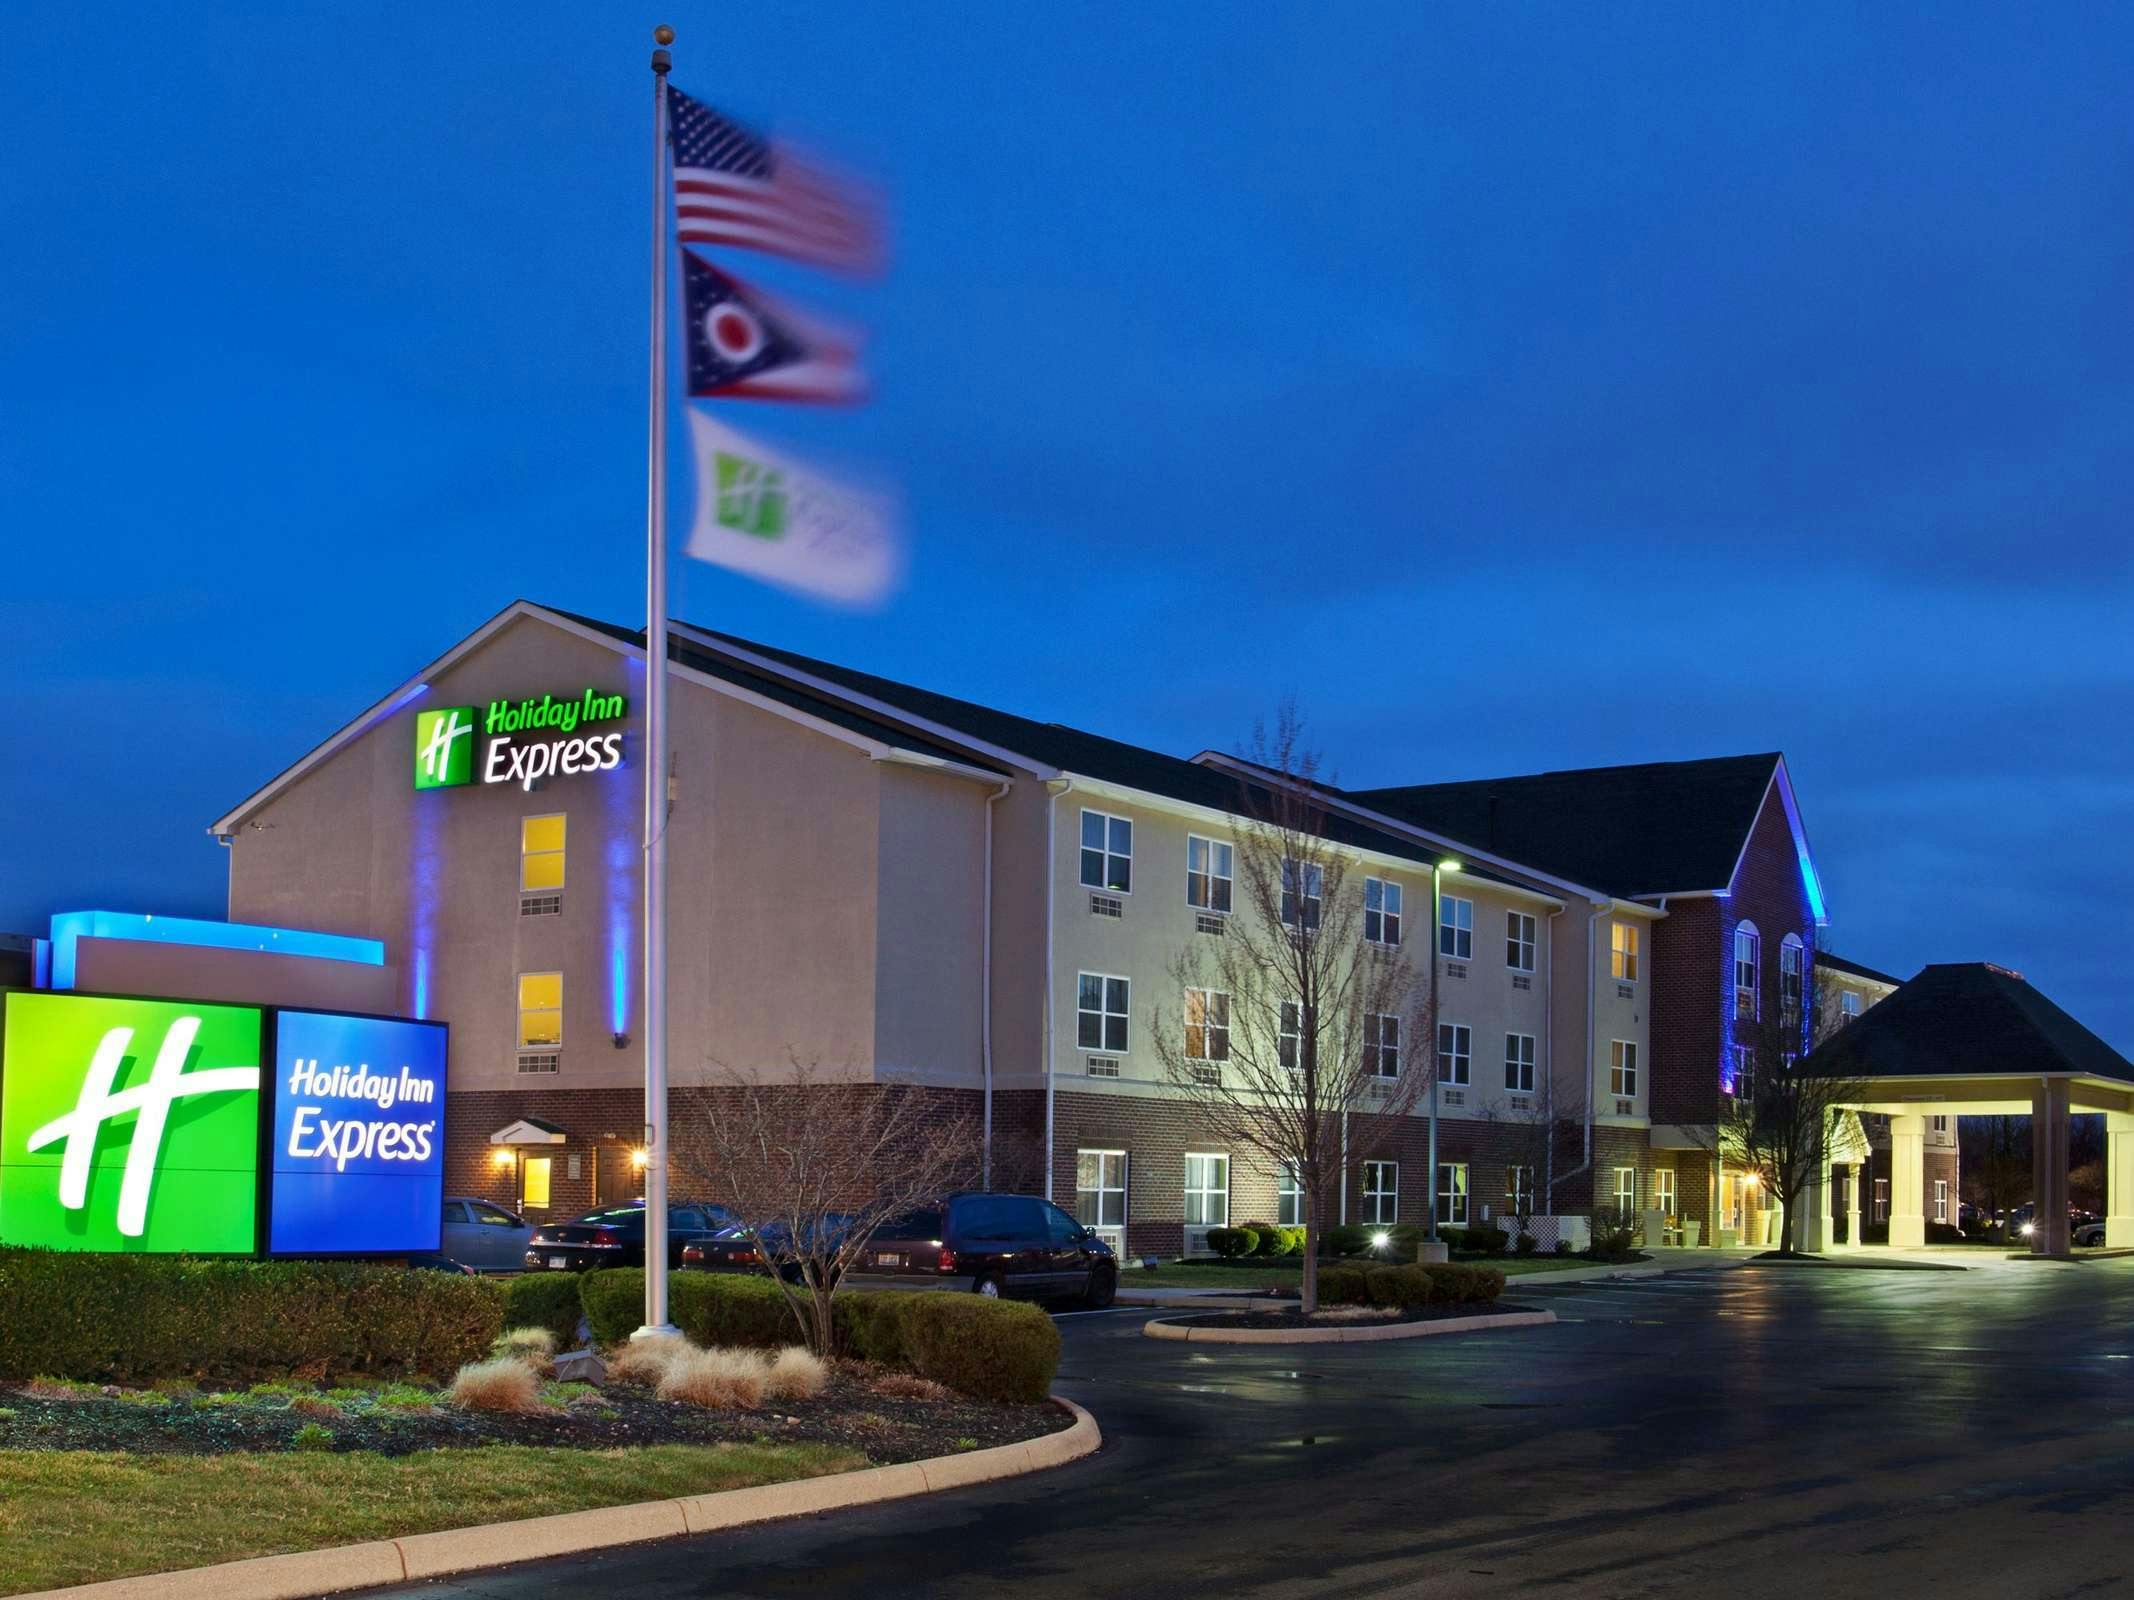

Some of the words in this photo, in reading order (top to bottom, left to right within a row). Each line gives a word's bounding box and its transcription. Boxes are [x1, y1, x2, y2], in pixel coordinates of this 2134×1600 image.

[486, 695, 580, 734] Holiday
[582, 688, 623, 722] Inn
[484, 733, 622, 792] Express
[288, 1058, 398, 1109] Holiday
[398, 1066, 434, 1103] Inn
[288, 1106, 433, 1173] Express
